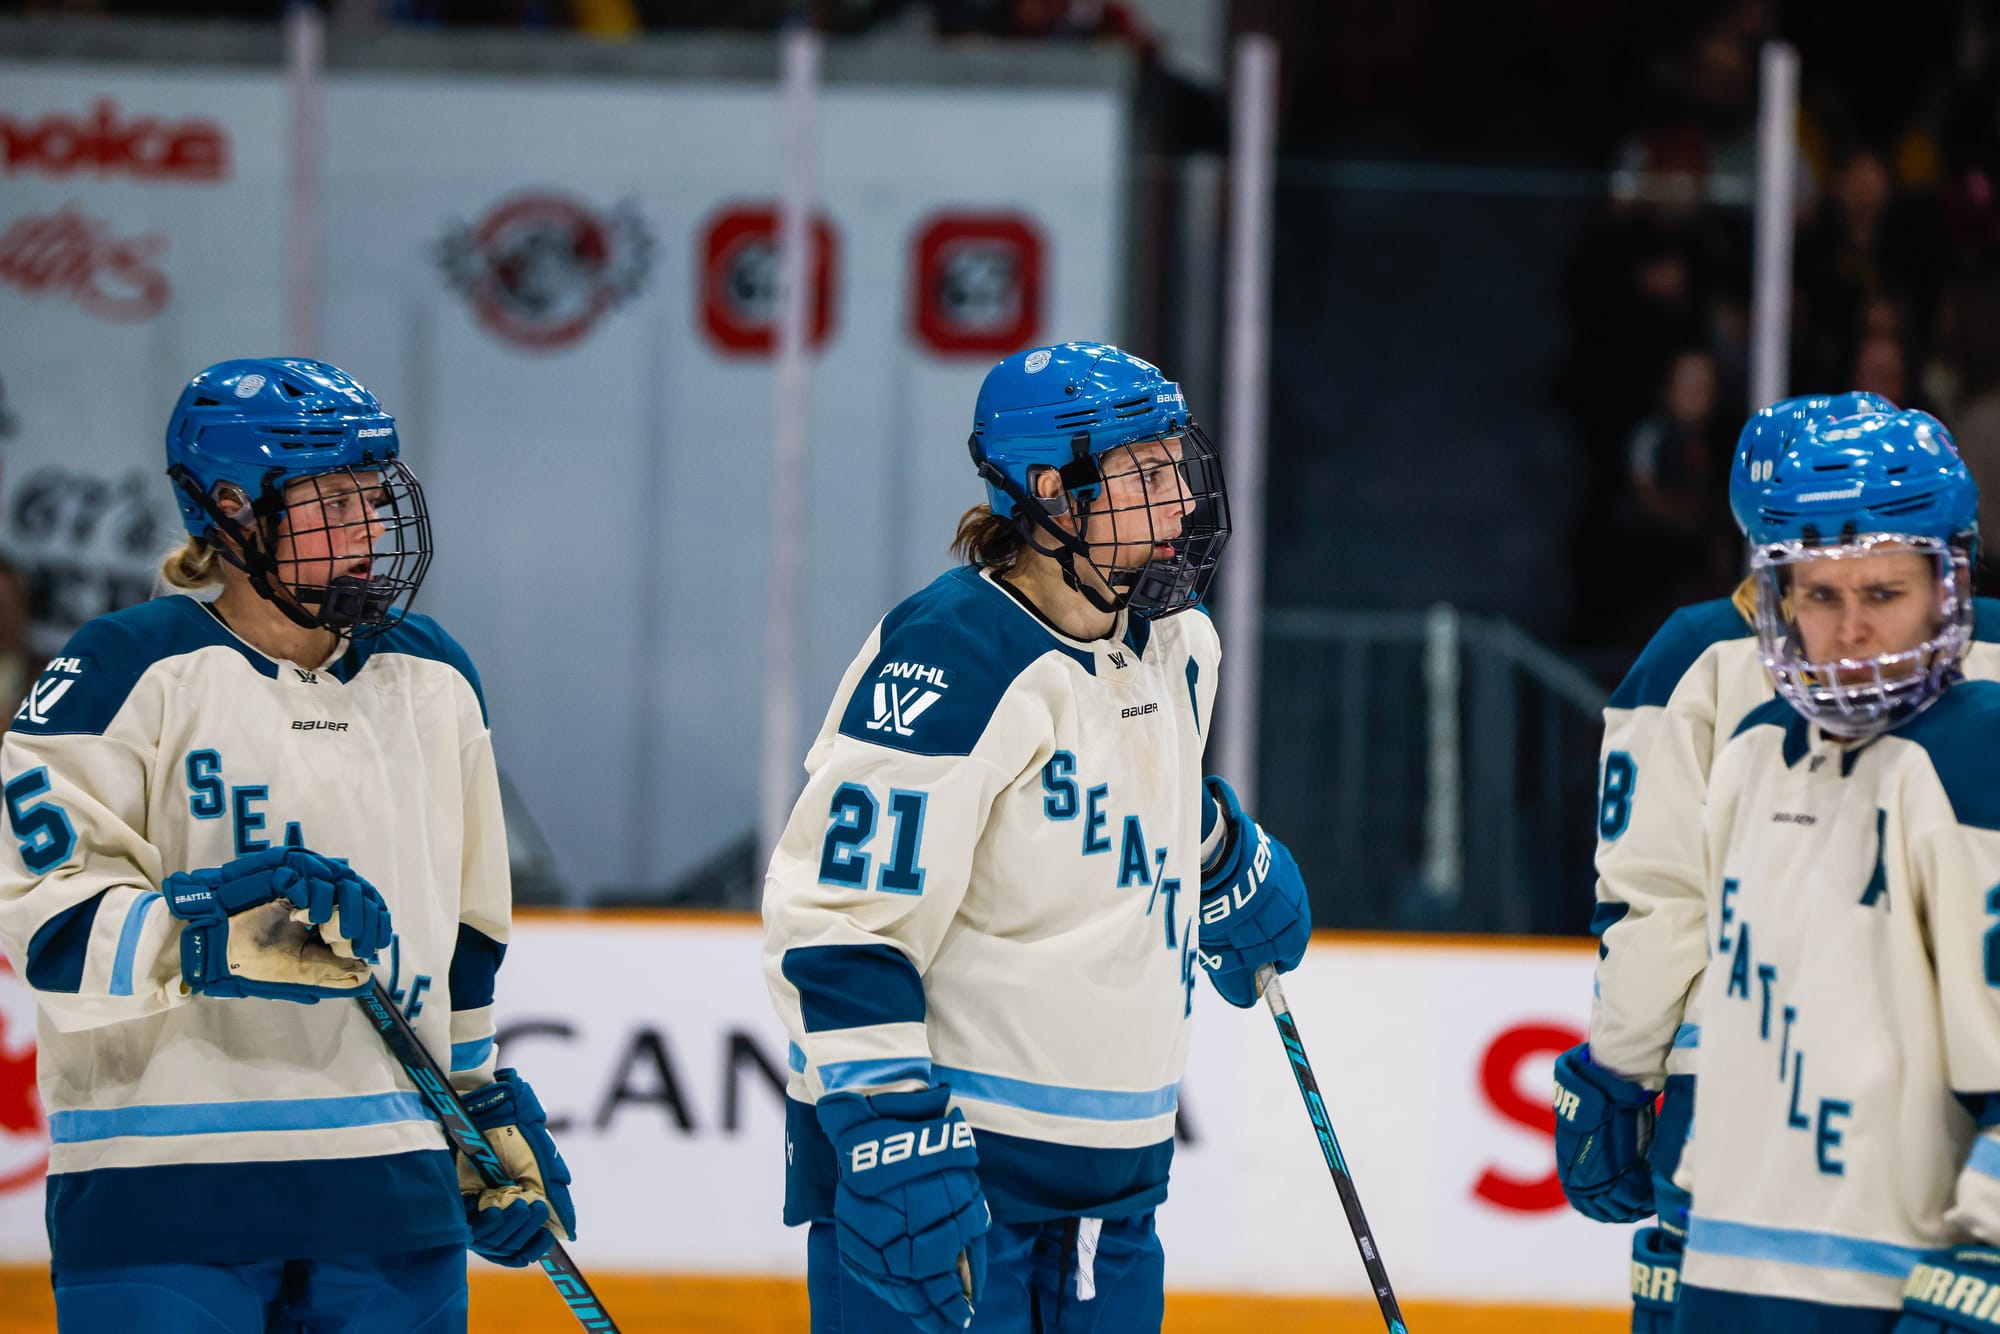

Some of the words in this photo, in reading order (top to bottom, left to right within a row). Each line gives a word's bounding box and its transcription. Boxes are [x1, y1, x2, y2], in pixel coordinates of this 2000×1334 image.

[879, 662, 949, 689] PWHL
[291, 720, 349, 732] BAUER
[1121, 702, 1159, 719] BAUER
[1600, 750, 1638, 842] 8
[818, 781, 929, 896] 21
[175, 891, 212, 904] SEATTLE
[1202, 823, 1272, 925] AUER
[1708, 876, 1852, 1177] EATTLE
[852, 1121, 977, 1173] BAUE
